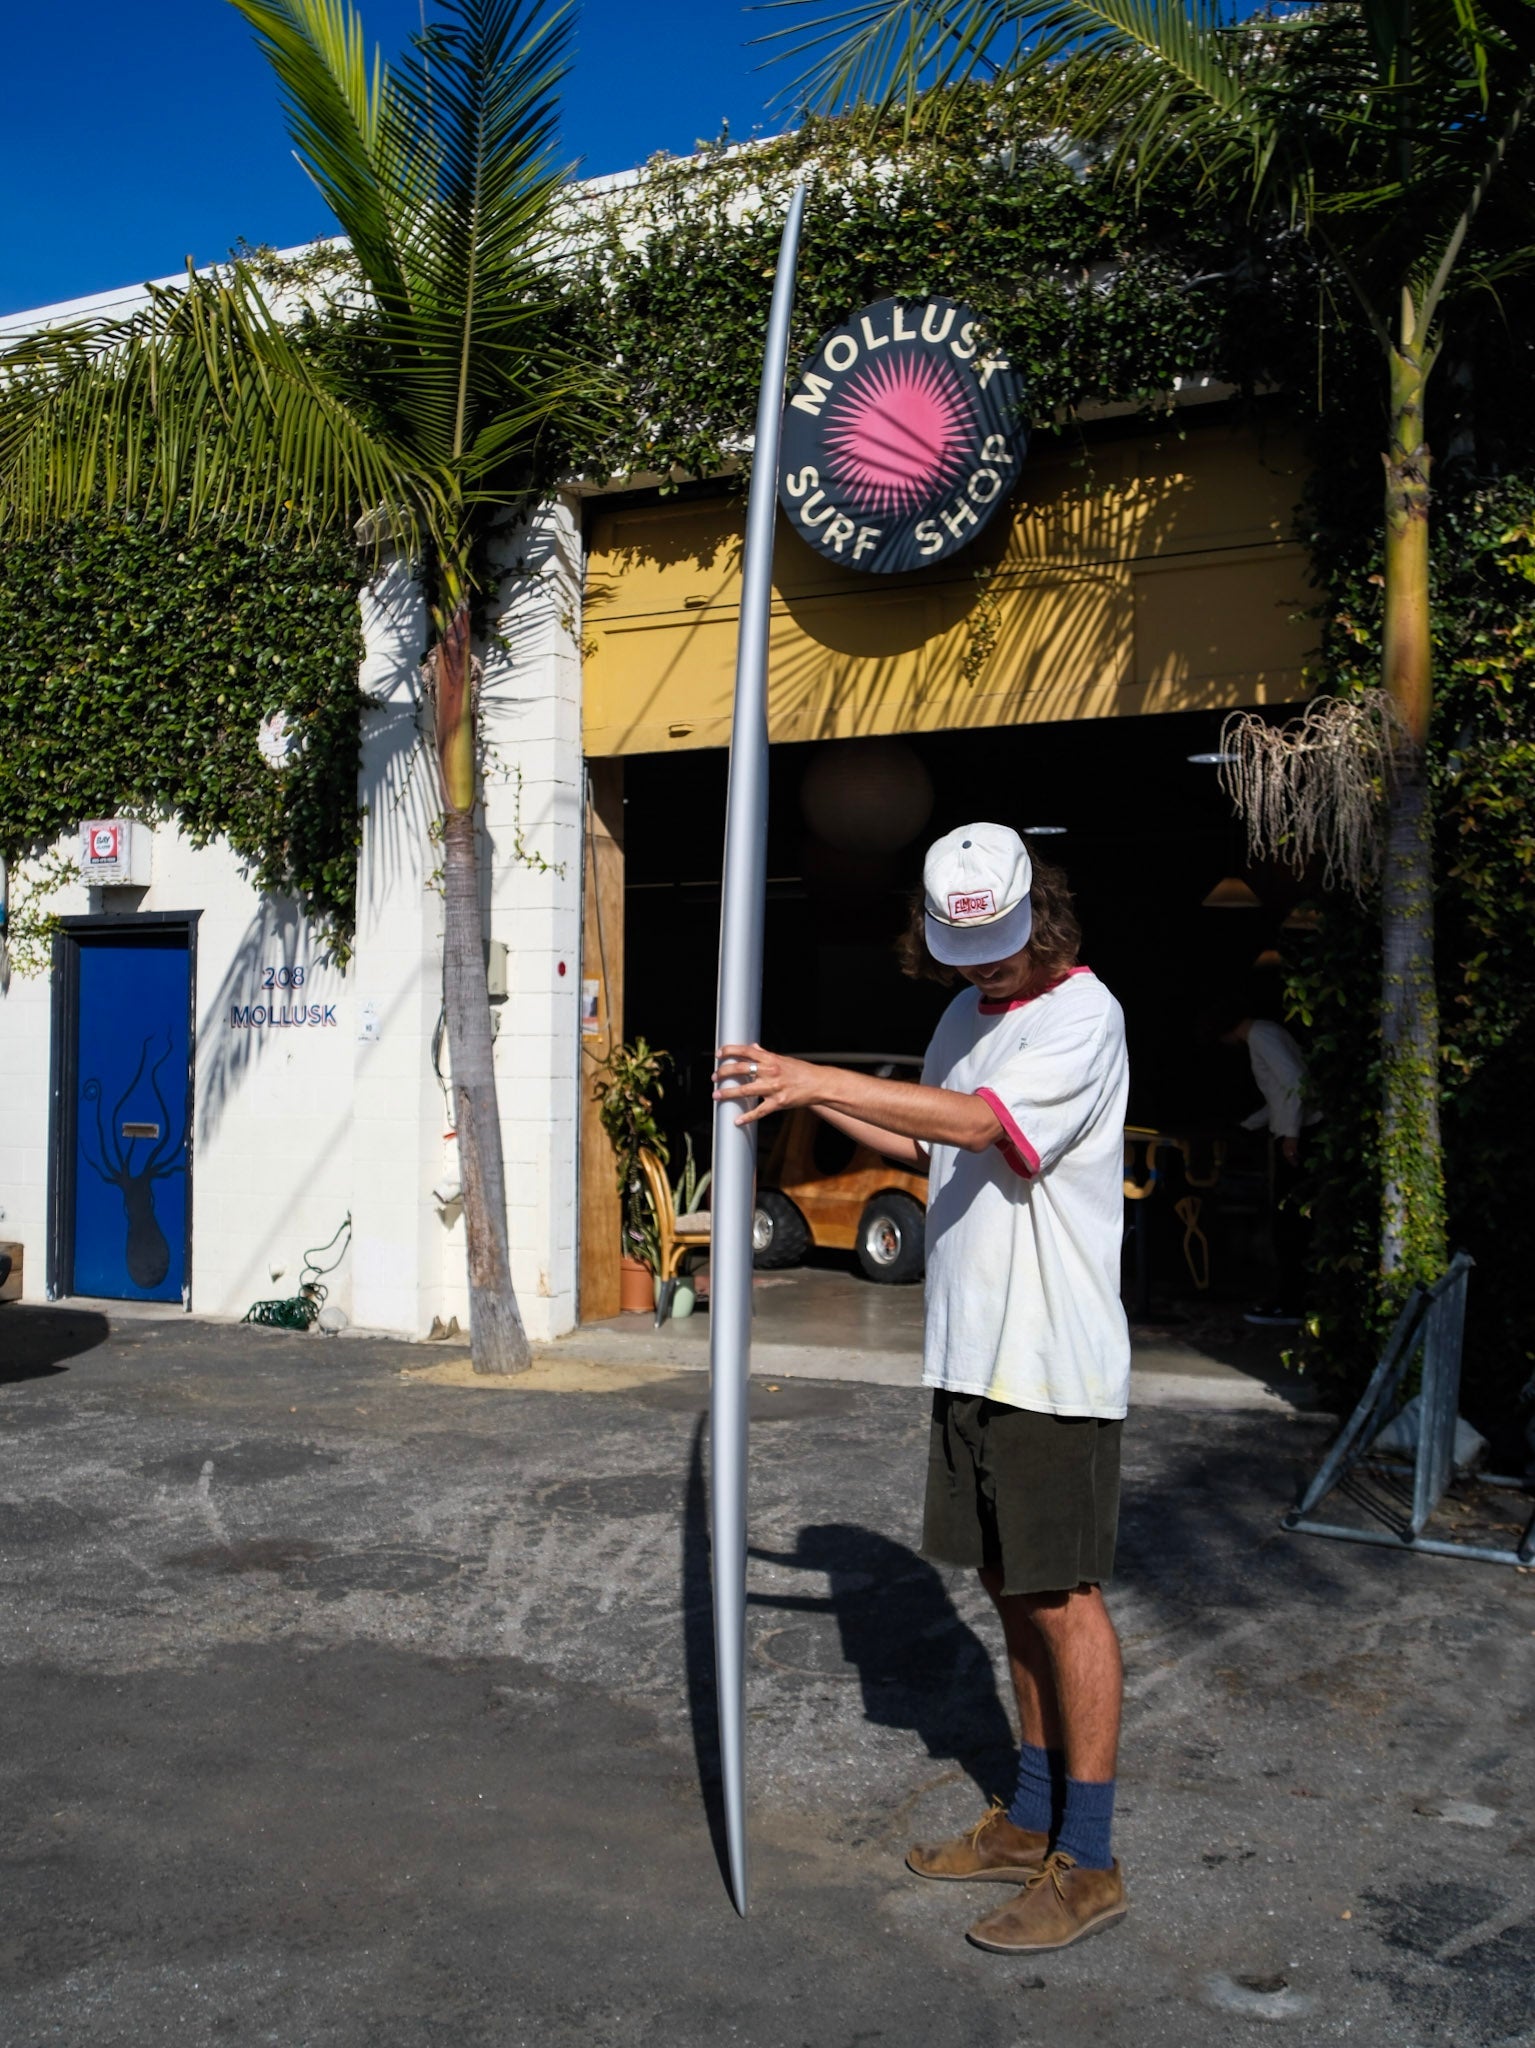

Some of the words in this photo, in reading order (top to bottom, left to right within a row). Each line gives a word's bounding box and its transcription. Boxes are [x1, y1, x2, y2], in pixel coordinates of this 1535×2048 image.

[786, 465, 882, 560] SURF
[915, 433, 1013, 555] SHOP
[262, 966, 305, 989] 208
[231, 1004, 337, 1028] MOLLUSK
